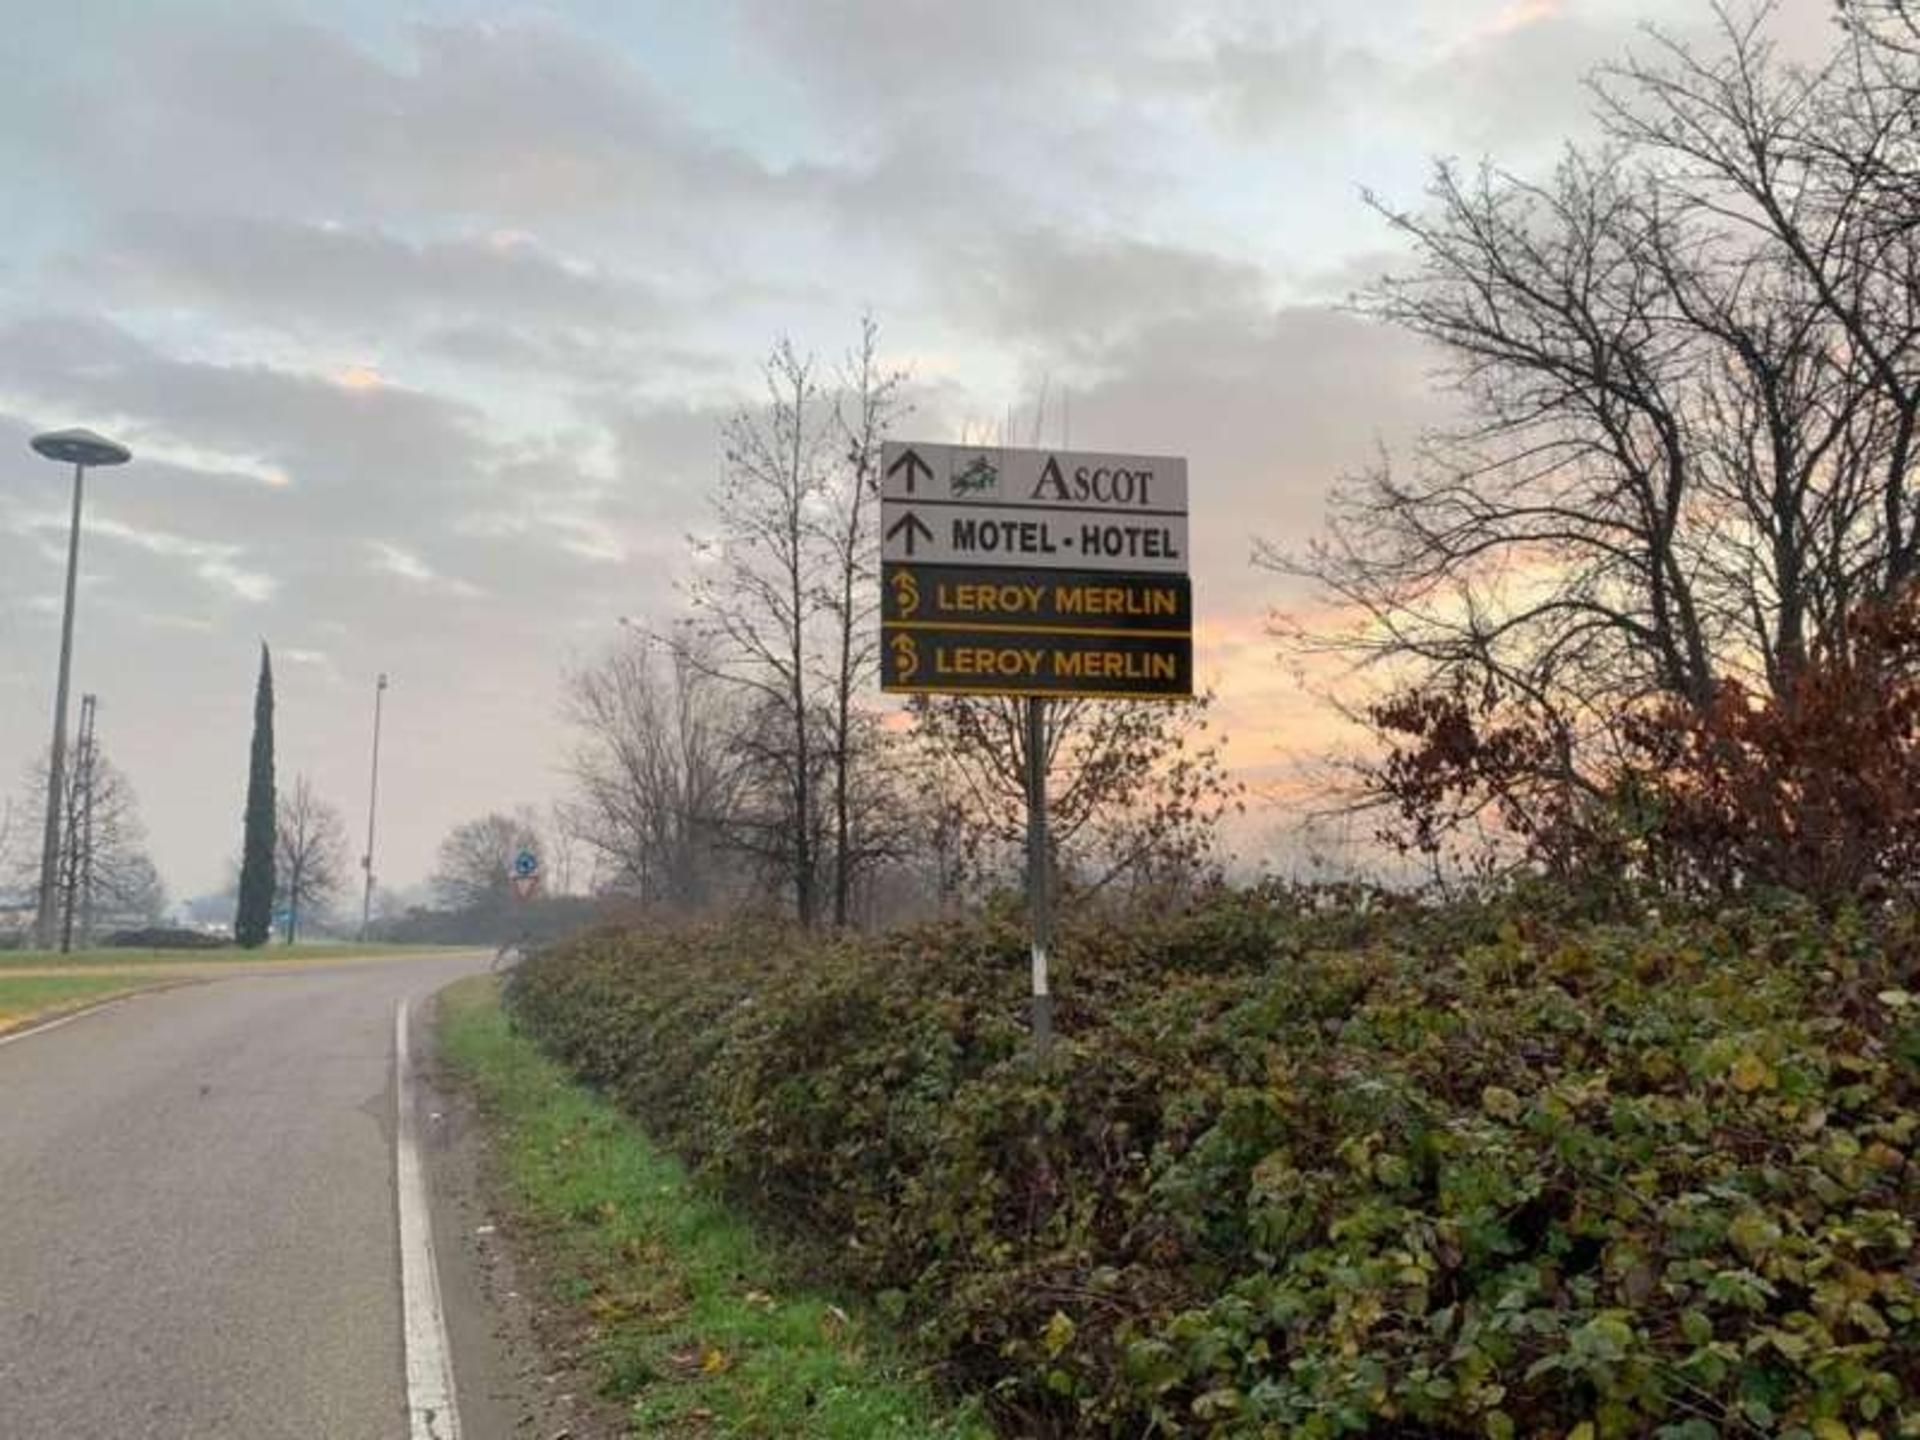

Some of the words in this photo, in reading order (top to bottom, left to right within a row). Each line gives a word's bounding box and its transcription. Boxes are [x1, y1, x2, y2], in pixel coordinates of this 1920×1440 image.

[952, 519, 1056, 552] MOTEL
[1081, 525, 1179, 559] HOTEL
[937, 584, 1046, 613] LEROY
[1055, 591, 1177, 615] MERLIN
[935, 649, 1044, 675] LEROY
[1053, 654, 1175, 679] MERLIN
